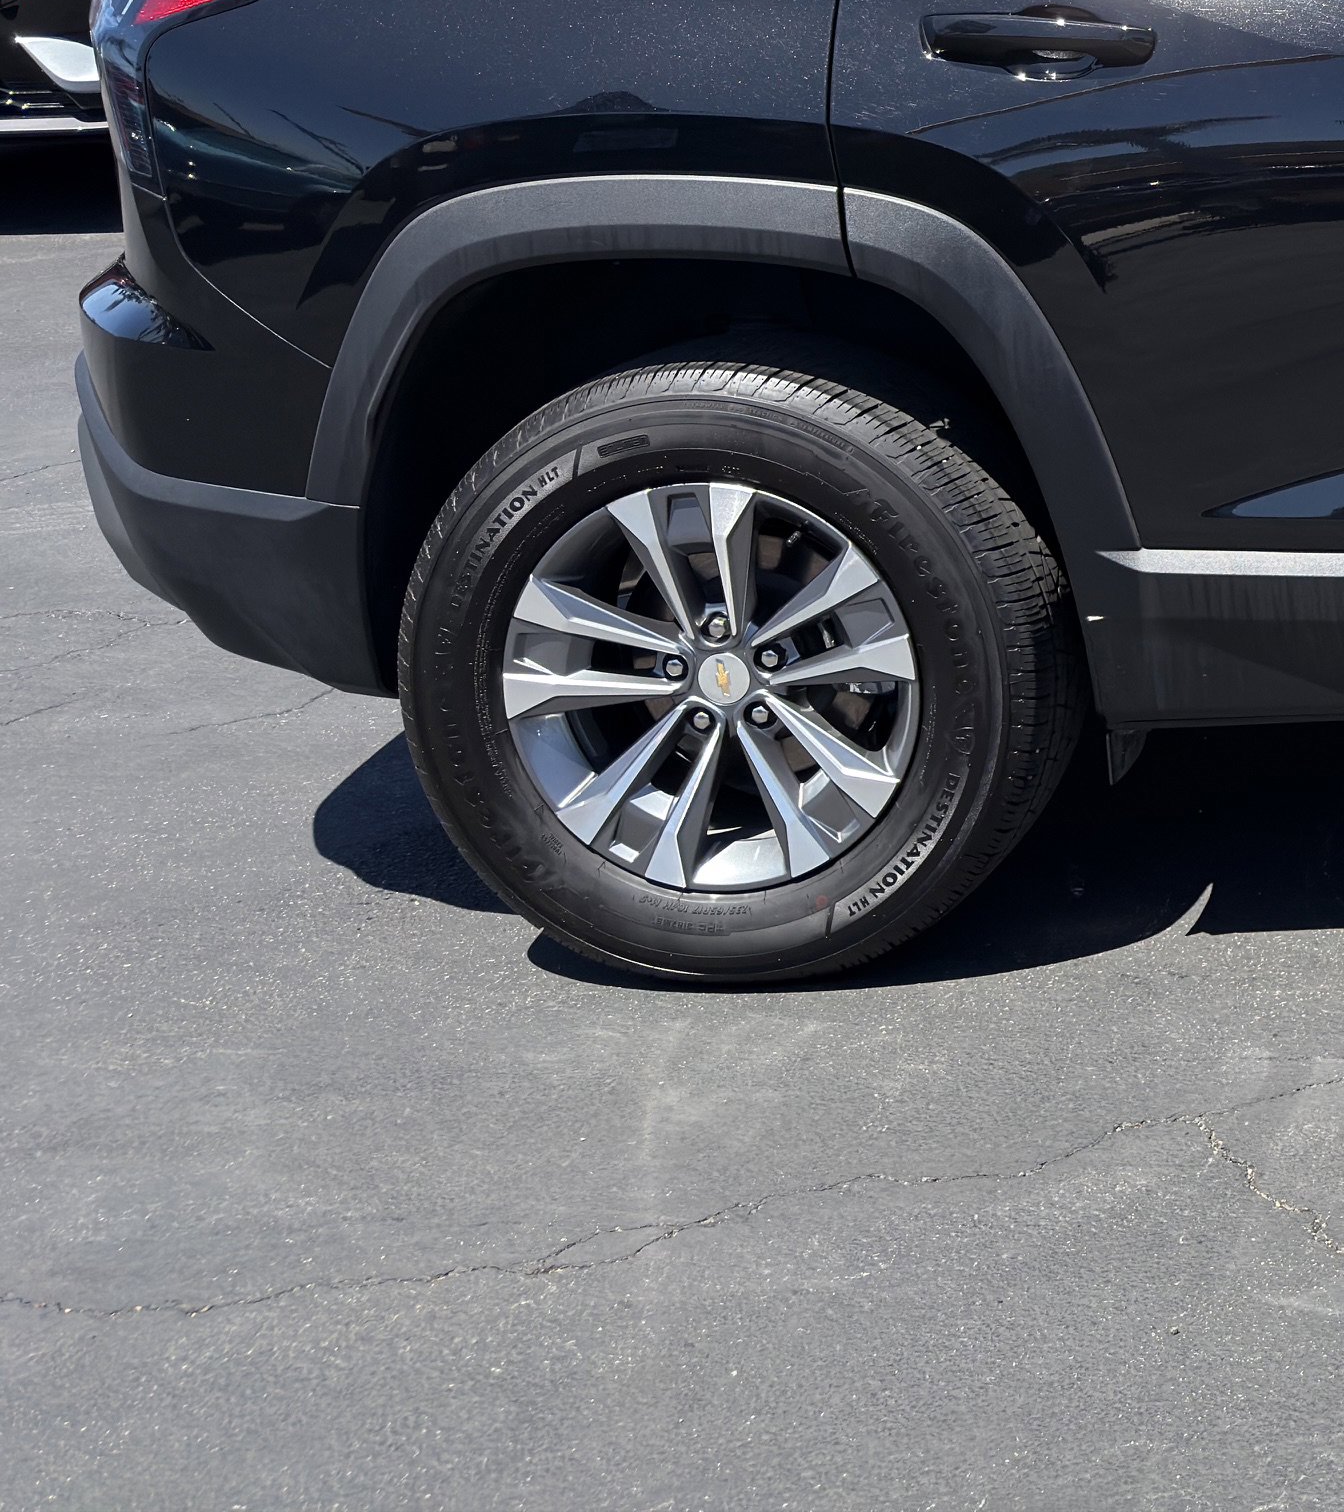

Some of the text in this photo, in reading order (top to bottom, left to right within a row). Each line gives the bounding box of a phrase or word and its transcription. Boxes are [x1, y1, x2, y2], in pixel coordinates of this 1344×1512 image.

[538, 465, 560, 489] HLT
[848, 772, 961, 917] DESTINATION HLT
